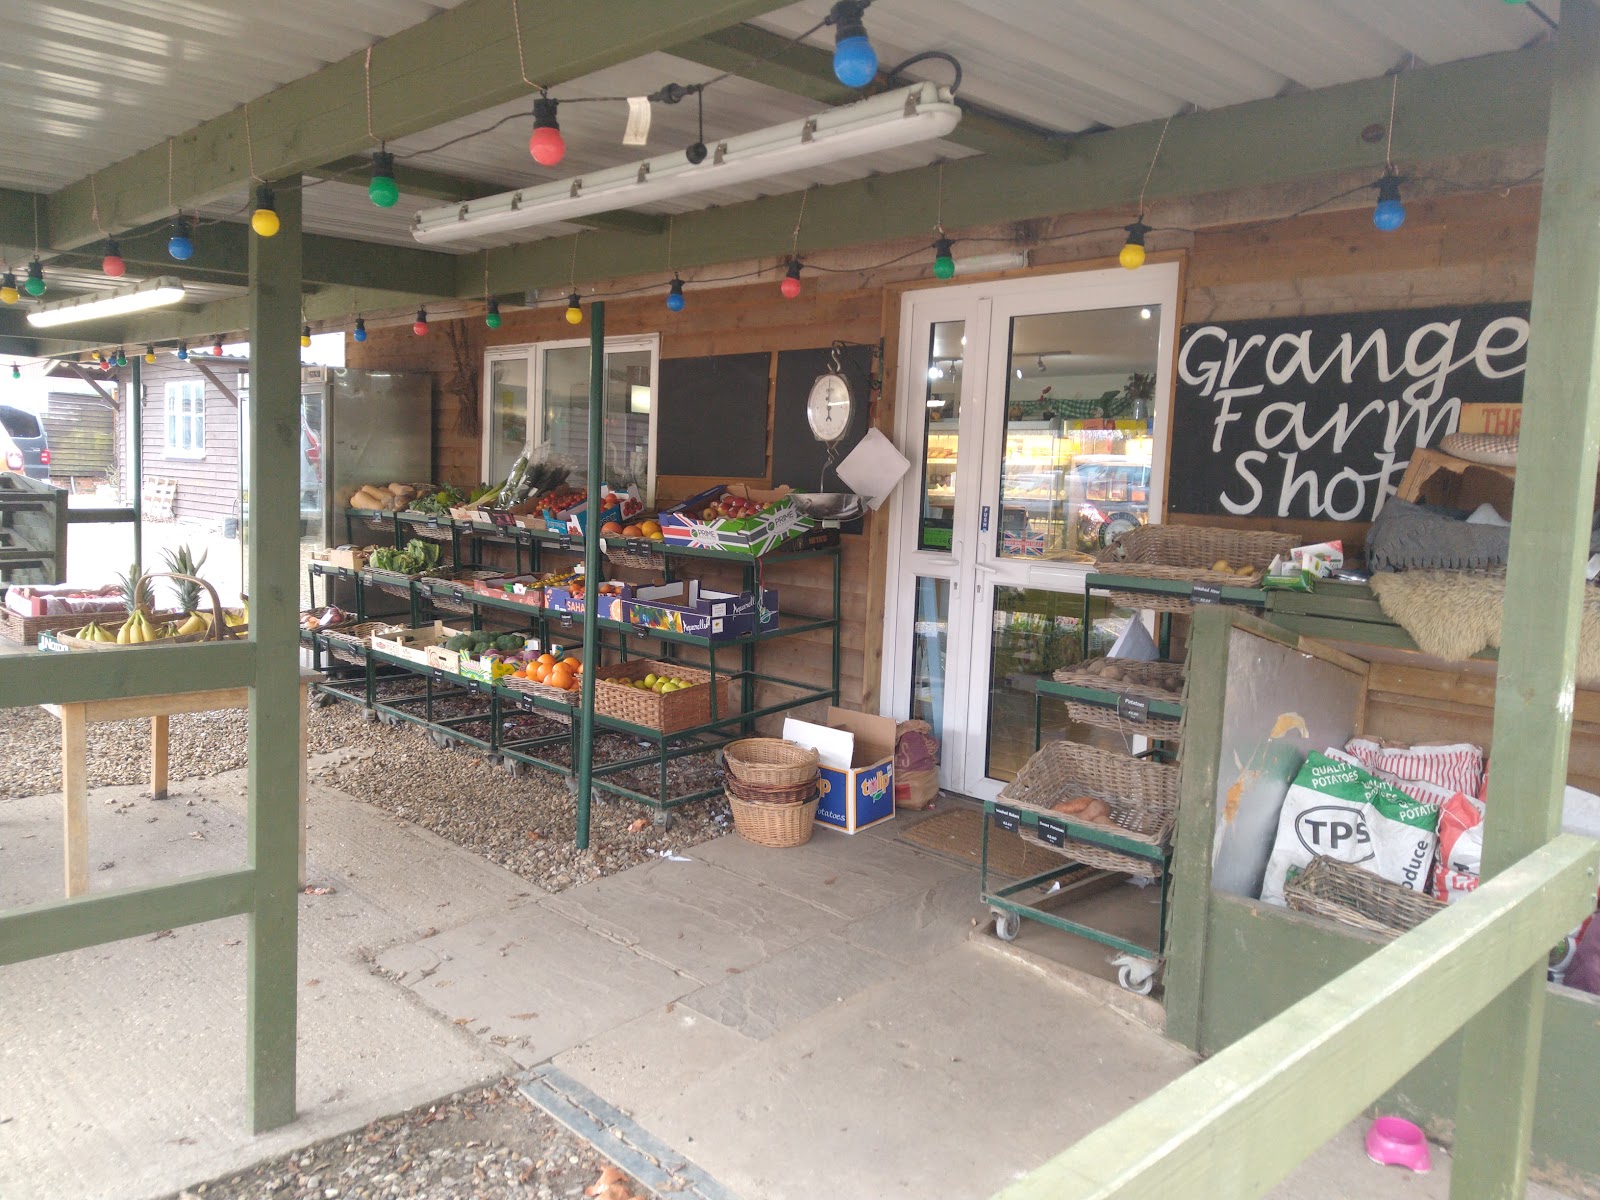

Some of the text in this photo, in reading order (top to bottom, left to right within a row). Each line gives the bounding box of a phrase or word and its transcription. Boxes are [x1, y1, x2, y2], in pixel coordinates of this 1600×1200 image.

[1178, 316, 1530, 405] Grange
[1213, 385, 1461, 453] Farm
[775, 511, 794, 527] PRIME
[698, 529, 715, 538] PRIME
[1124, 698, 1145, 708] Potatoes
[1312, 762, 1352, 777] QUALITY
[1312, 770, 1358, 789] POTATOES
[817, 806, 846, 821] otatoes
[1305, 819, 1371, 849] TPS
